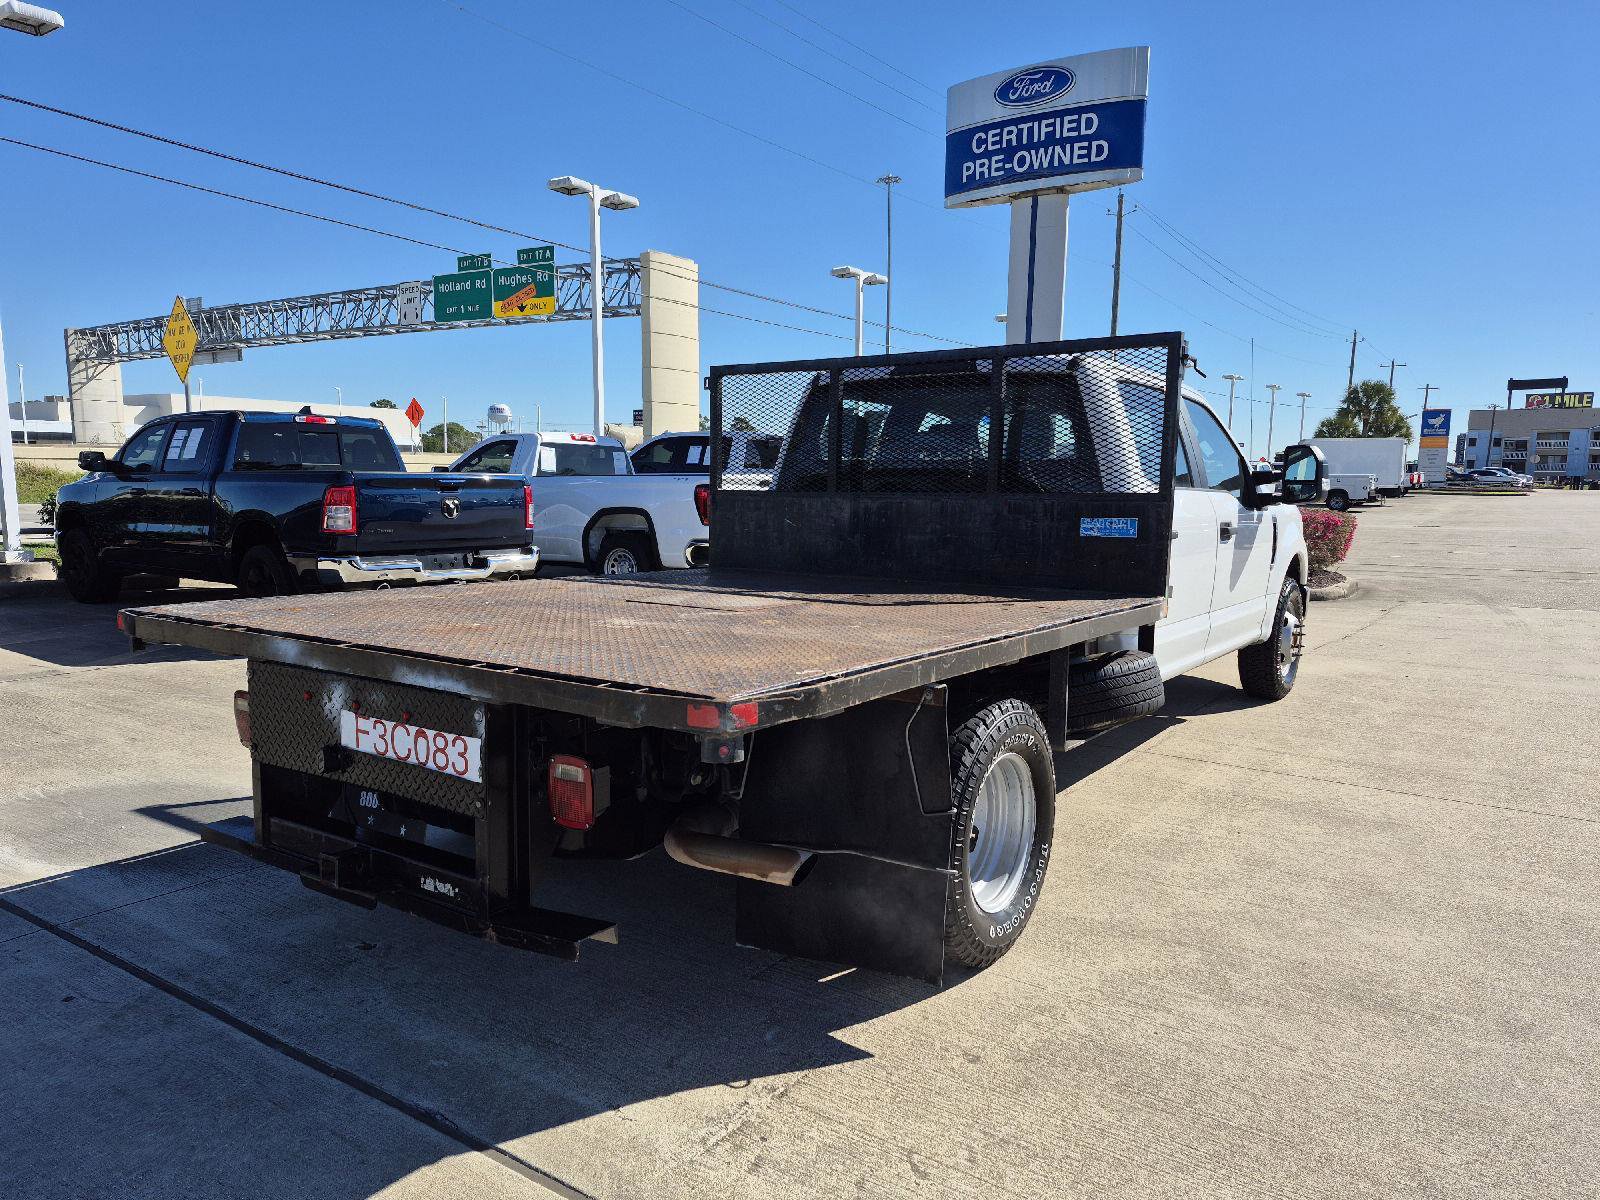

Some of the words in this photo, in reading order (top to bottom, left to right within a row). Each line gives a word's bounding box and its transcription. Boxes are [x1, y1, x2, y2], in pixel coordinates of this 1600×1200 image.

[1008, 72, 1055, 100] Ford
[971, 112, 1099, 154] CERTIFIED
[962, 139, 1109, 184] PRE-OWNED
[438, 280, 471, 293] Holland
[475, 278, 486, 289] Rd
[498, 273, 532, 287] Hughes
[536, 270, 549, 282] Rd
[400, 286, 420, 295] SPEED
[460, 304, 465, 314] 1
[529, 301, 548, 310] ONLY
[1554, 393, 1593, 408] MILE
[354, 713, 469, 776] F3C083
